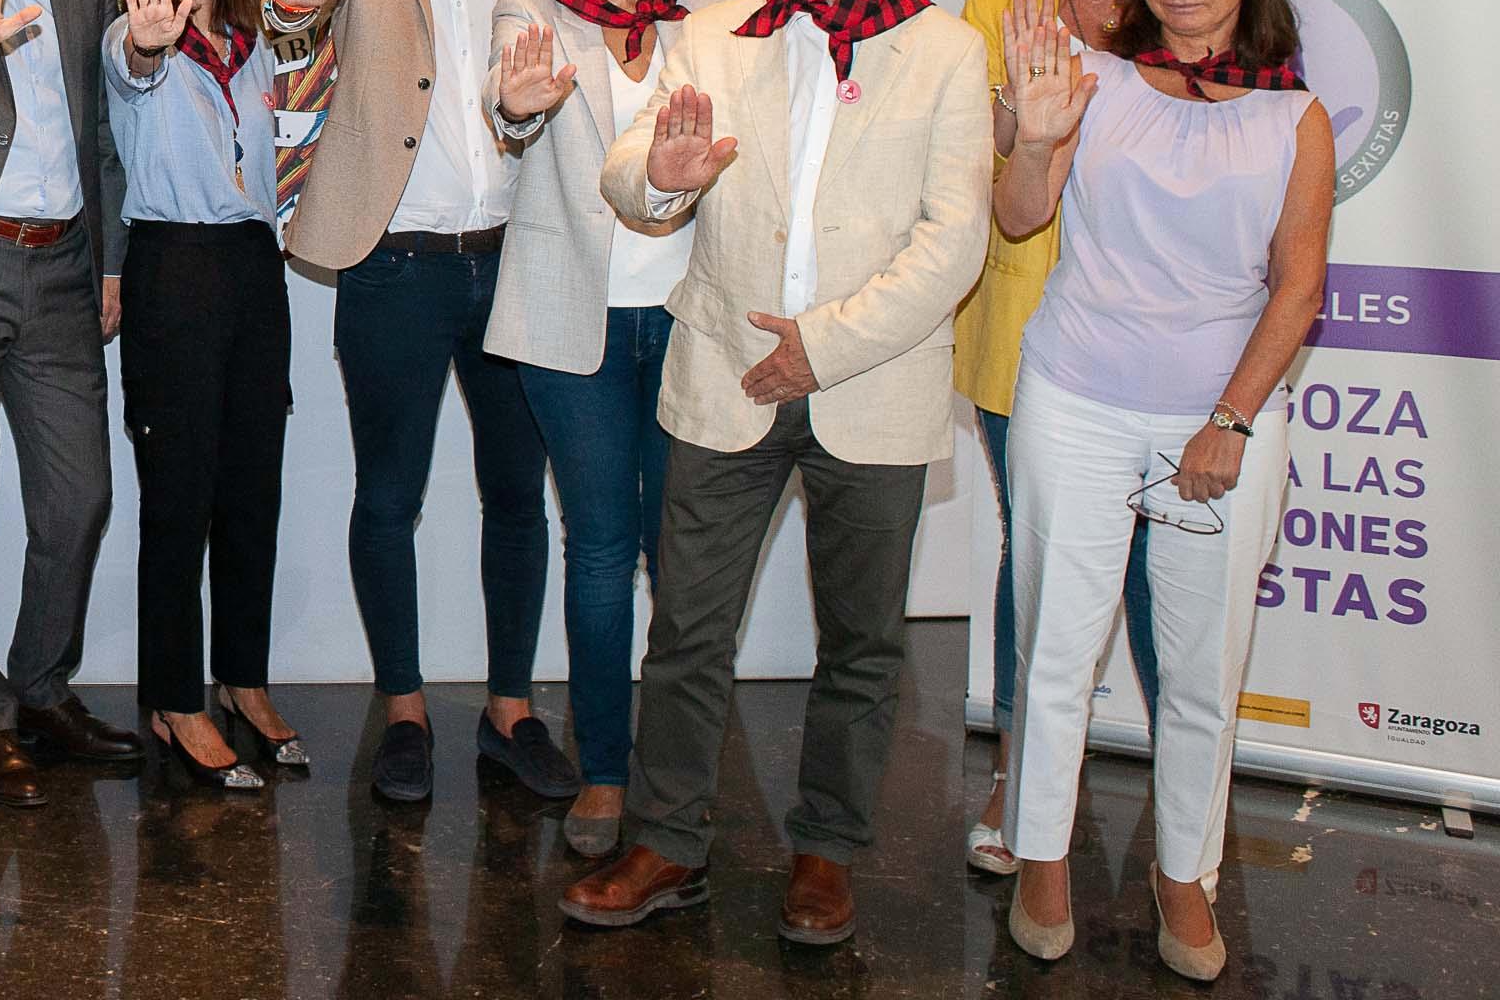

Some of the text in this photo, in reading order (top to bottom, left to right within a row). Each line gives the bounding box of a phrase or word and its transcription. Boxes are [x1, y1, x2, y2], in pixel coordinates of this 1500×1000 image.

[1340, 109, 1400, 189] SEXISTAS
[1323, 452, 1426, 499] LAS
[1387, 708, 1480, 736] Zaragoza
[1387, 725, 1431, 736] AYUNTAMIENTO
[1387, 734, 1426, 746] IGUALDAD
